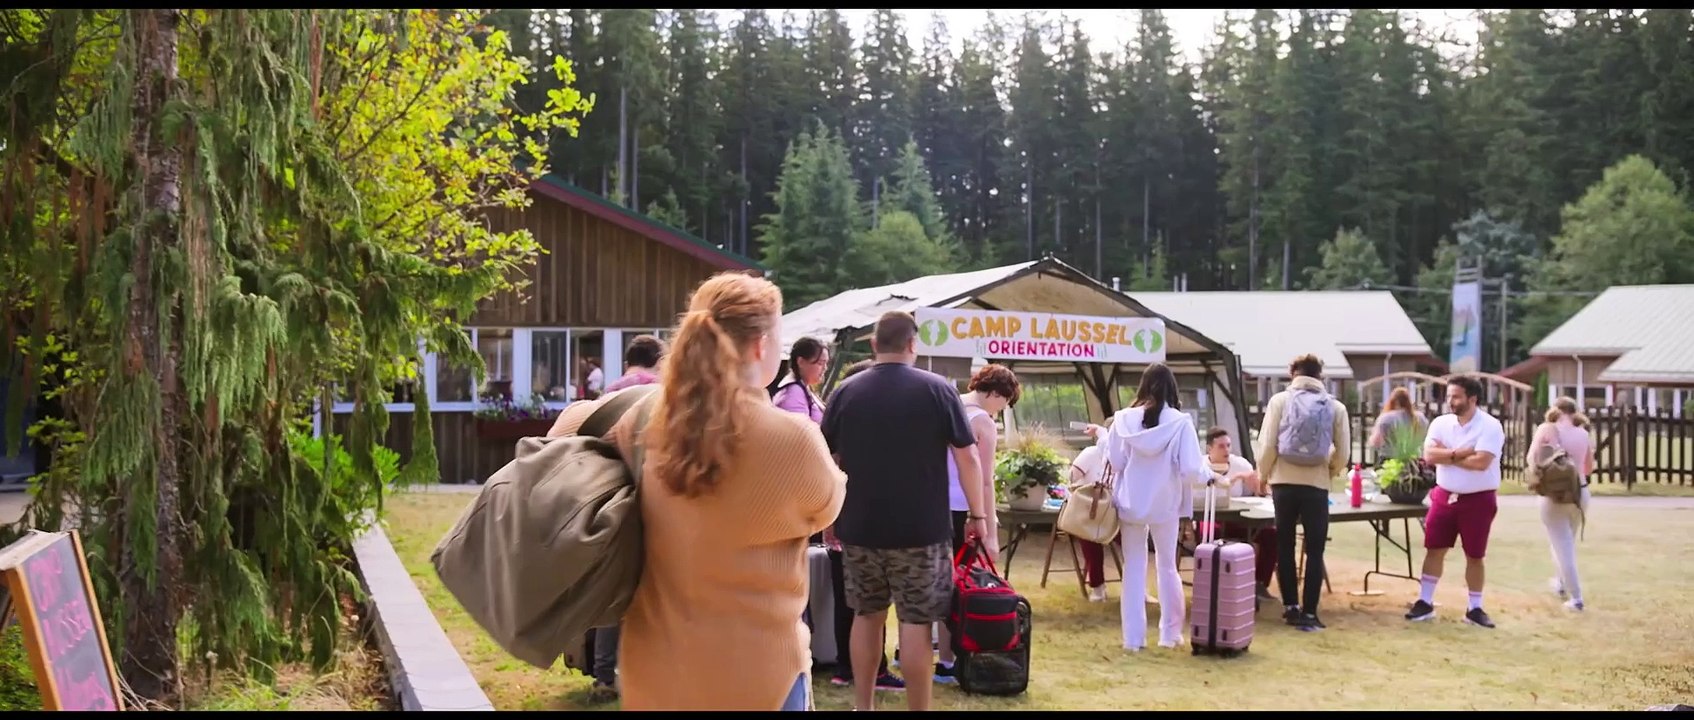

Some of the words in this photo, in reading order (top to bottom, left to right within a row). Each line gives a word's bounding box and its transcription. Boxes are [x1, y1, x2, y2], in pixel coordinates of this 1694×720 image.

[951, 316, 1022, 339] CAMP
[1031, 317, 1132, 346] LAUSSEL
[988, 340, 1095, 357] ORIENTATION
